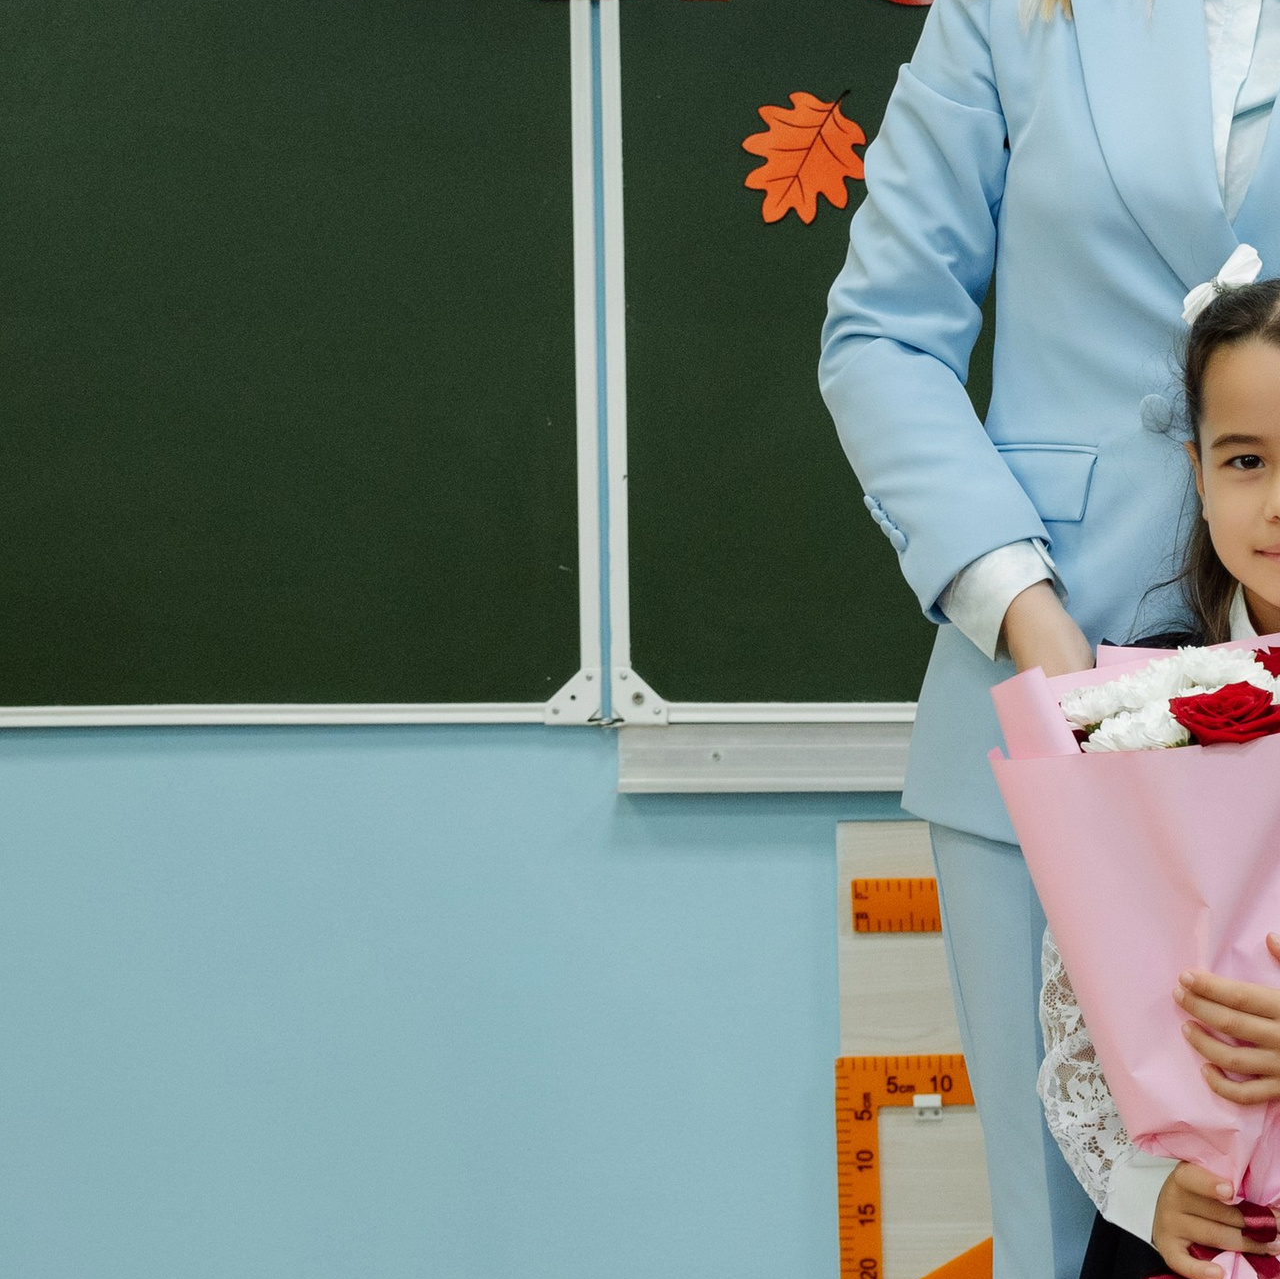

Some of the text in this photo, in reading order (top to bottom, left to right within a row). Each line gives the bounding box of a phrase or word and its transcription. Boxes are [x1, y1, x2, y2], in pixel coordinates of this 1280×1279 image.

[929, 1074, 953, 1093] 10
[856, 1149, 874, 1172] 10
[857, 1203, 876, 1227] 15
